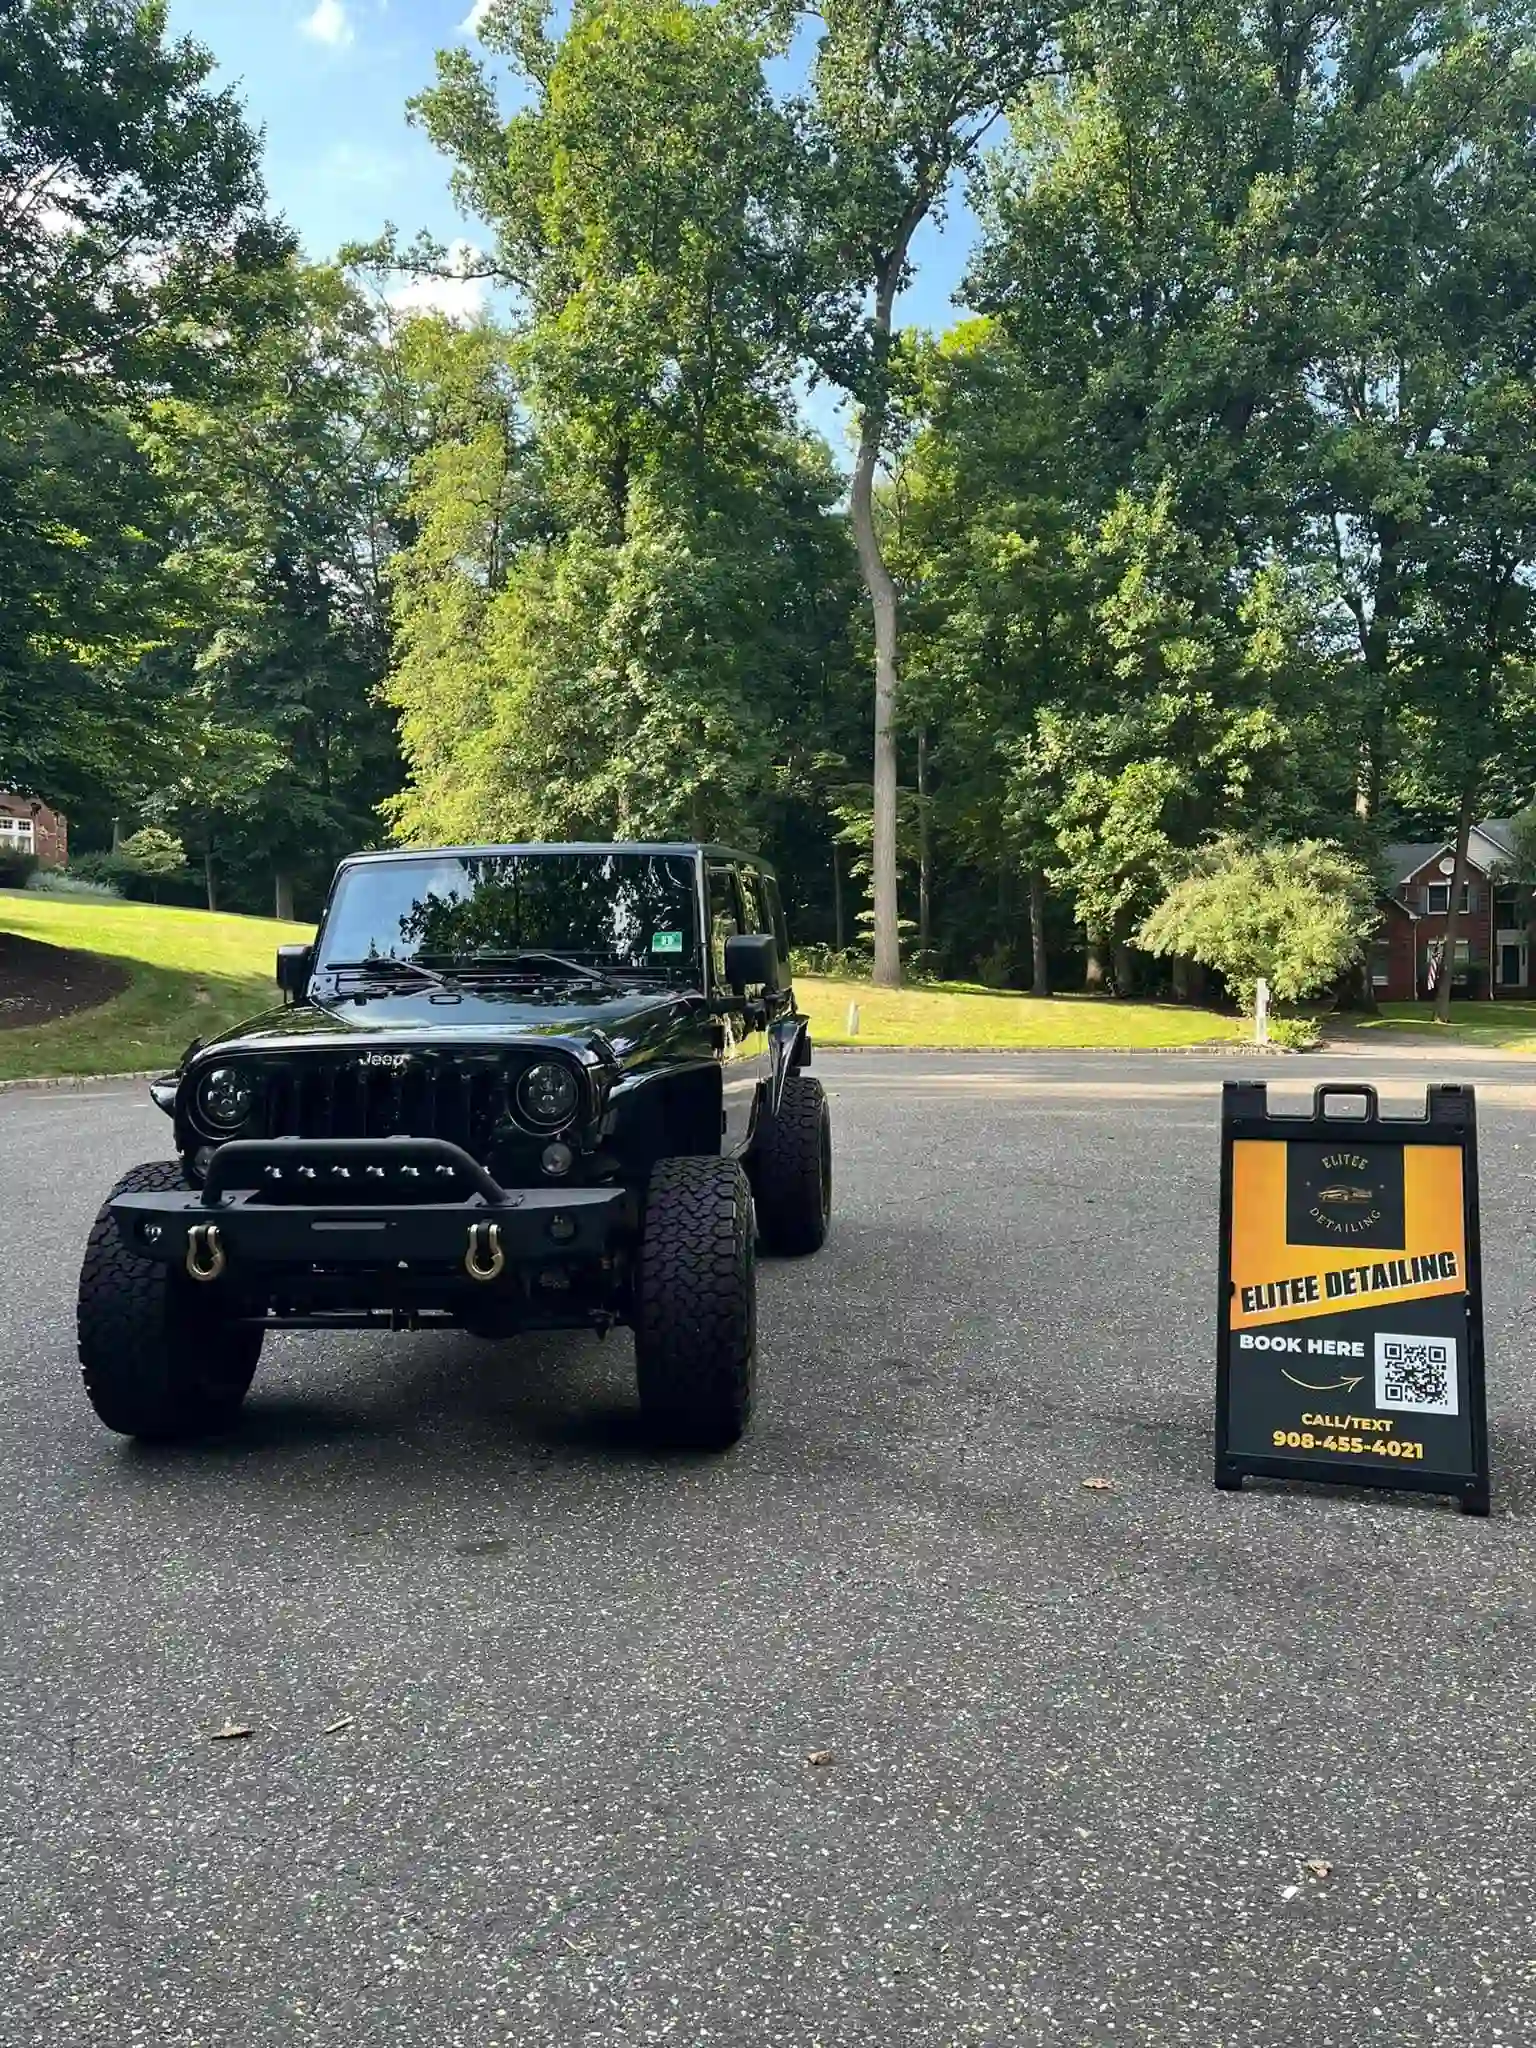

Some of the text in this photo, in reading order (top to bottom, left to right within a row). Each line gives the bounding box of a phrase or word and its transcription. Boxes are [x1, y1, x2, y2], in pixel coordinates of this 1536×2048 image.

[358, 1051, 404, 1069] Jeep
[1321, 1153, 1368, 1170] ELITEE
[1309, 1207, 1381, 1233] DETAILING
[1241, 1251, 1458, 1314] ELITEE DETAILING
[1239, 1334, 1365, 1358] BOOK HERE
[1301, 1412, 1394, 1432] CALL/TEXT
[1272, 1430, 1424, 1460] 908-455-4021
